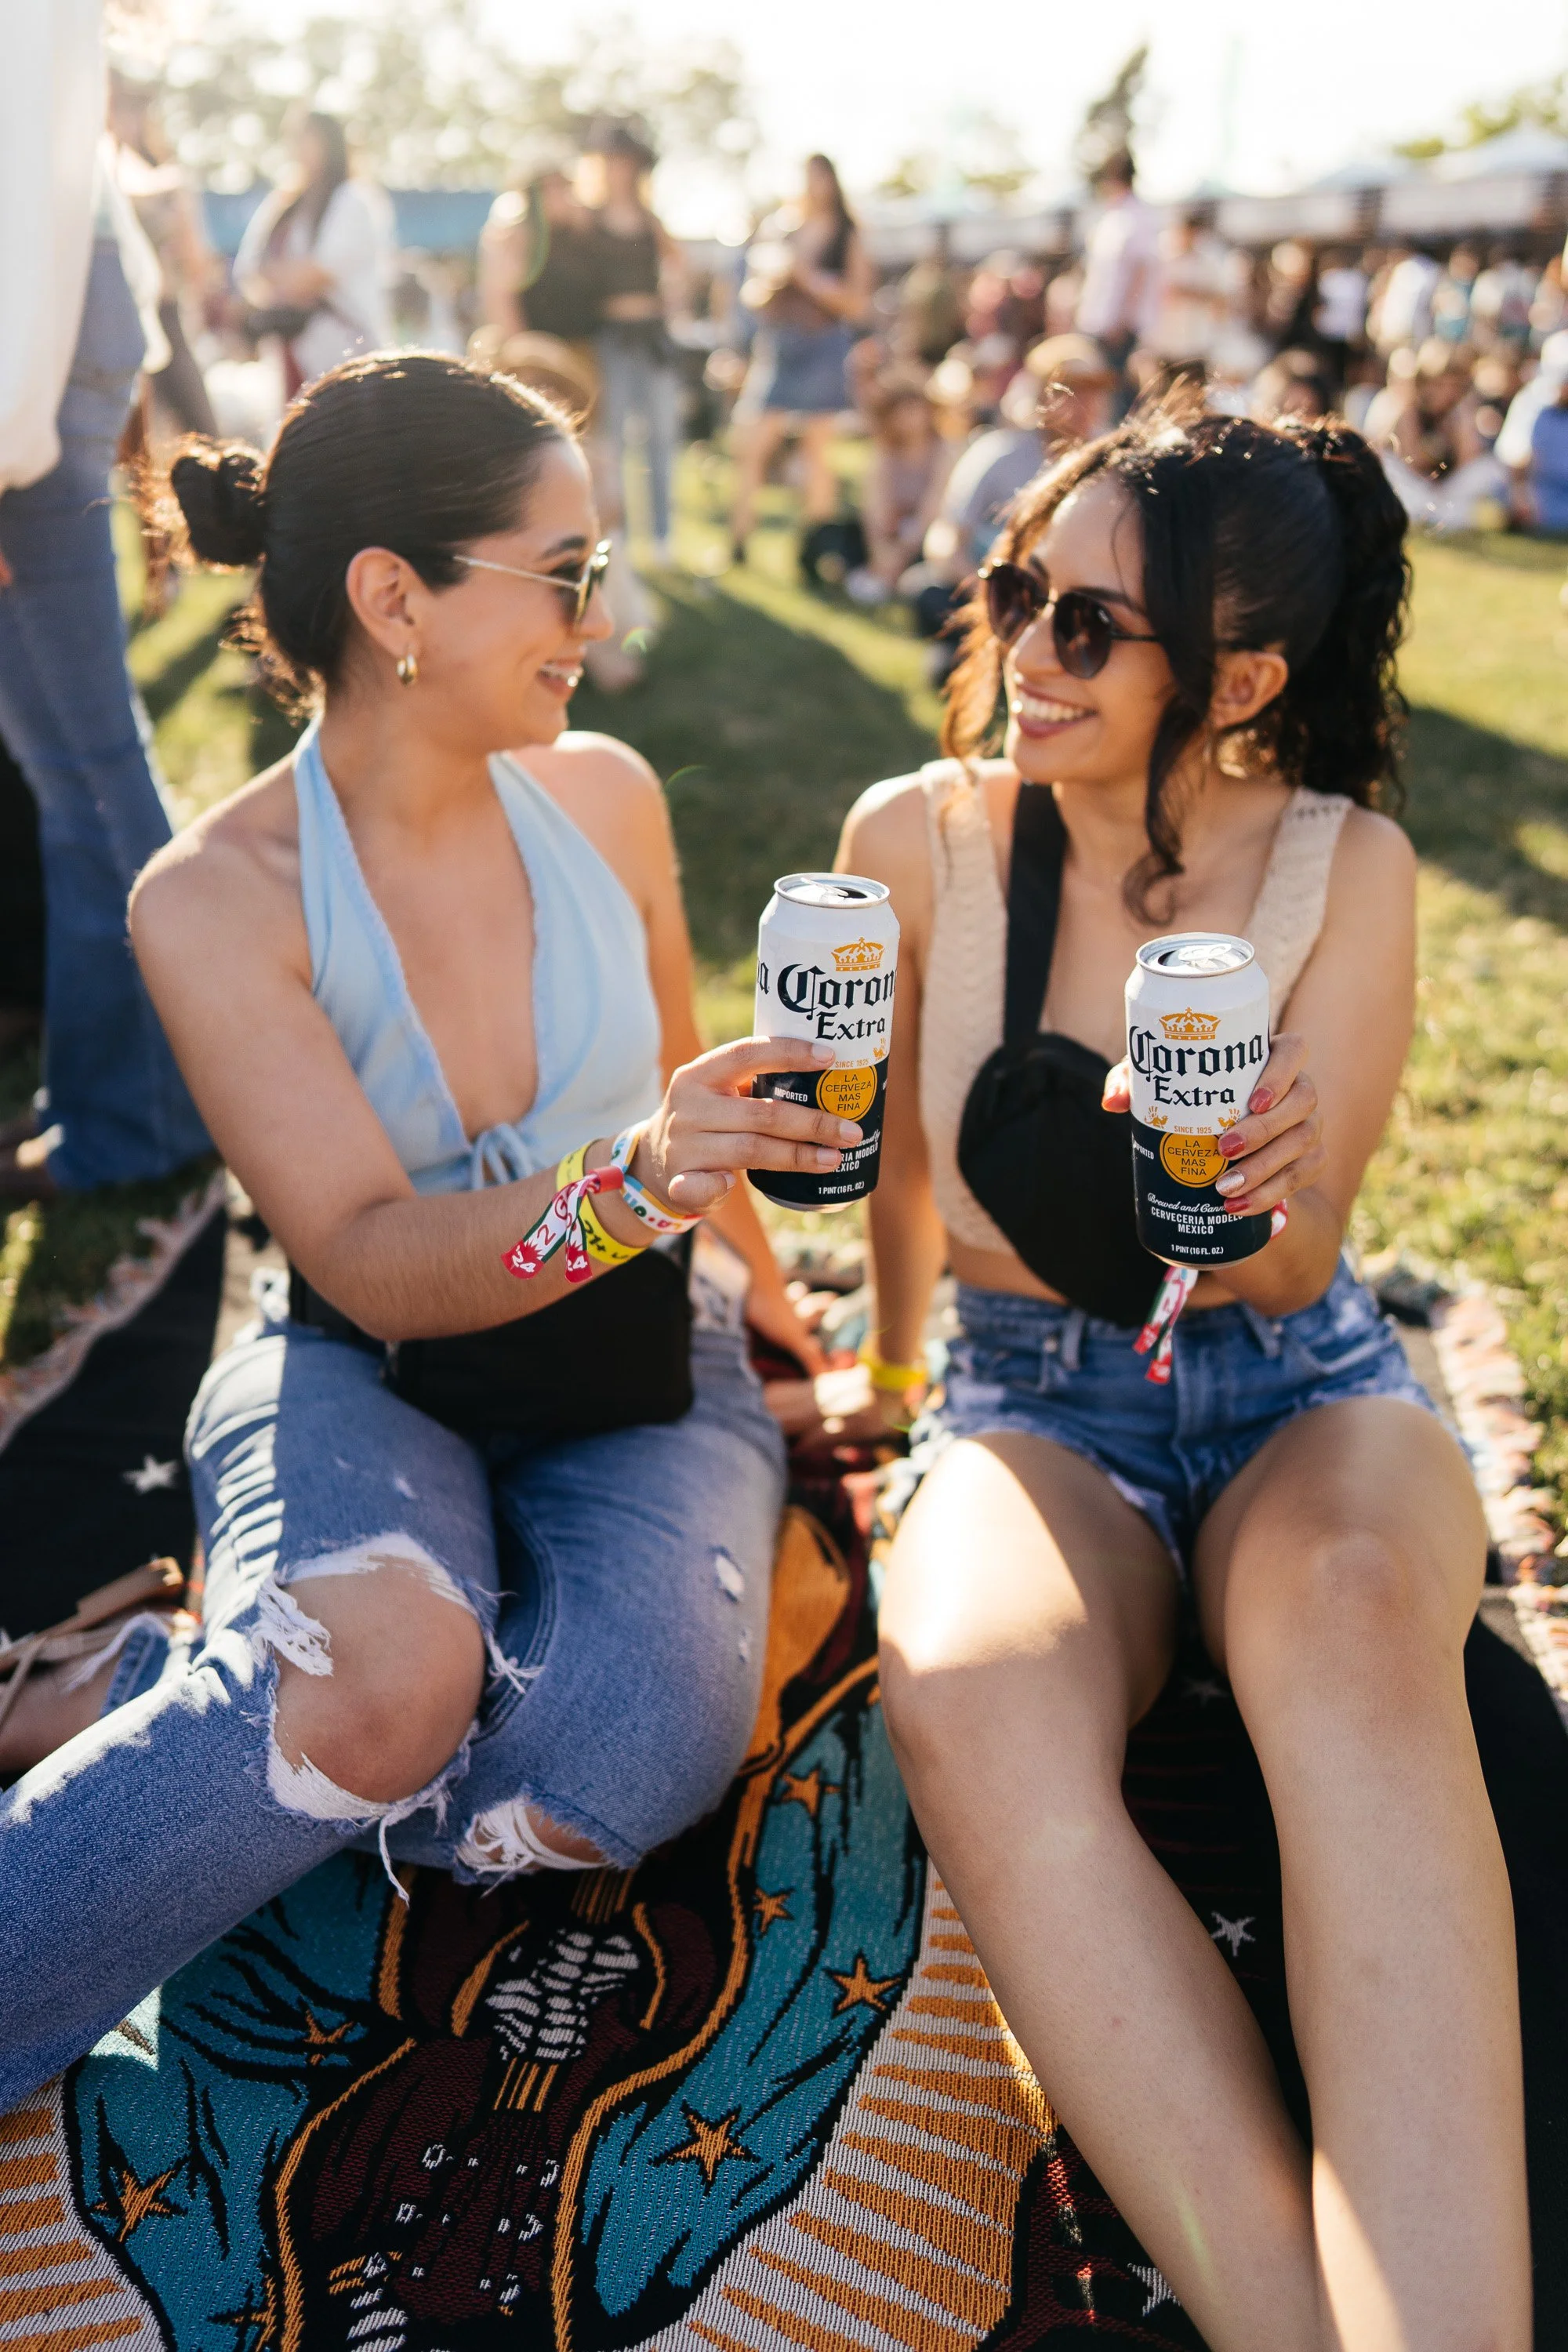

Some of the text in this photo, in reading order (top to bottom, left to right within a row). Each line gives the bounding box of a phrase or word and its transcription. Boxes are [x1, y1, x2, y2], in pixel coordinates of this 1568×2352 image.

[777, 964, 897, 1021] Coron
[815, 1011, 885, 1040] Extra
[1129, 1025, 1264, 1082] Corona
[844, 1073, 858, 1083] LA
[825, 1080, 872, 1093] CERVEZA
[1152, 1074, 1236, 1107] Extra
[775, 1087, 808, 1102] IMPORTED
[838, 1092, 861, 1102] MAS
[837, 1102, 861, 1112] FINA
[1174, 1125, 1194, 1134] SINCE
[1185, 1139, 1200, 1148] LA
[1167, 1146, 1221, 1157] CERVEZA
[1181, 1158, 1207, 1167] MAS
[1181, 1167, 1207, 1176] FINA
[1147, 1192, 1225, 1213] Brewed and Cann
[1151, 1206, 1204, 1225] CERVECERIA
[1178, 1223, 1214, 1235] MEXICO
[1175, 1245, 1189, 1254] PINT
[1189, 1247, 1200, 1255] (16
